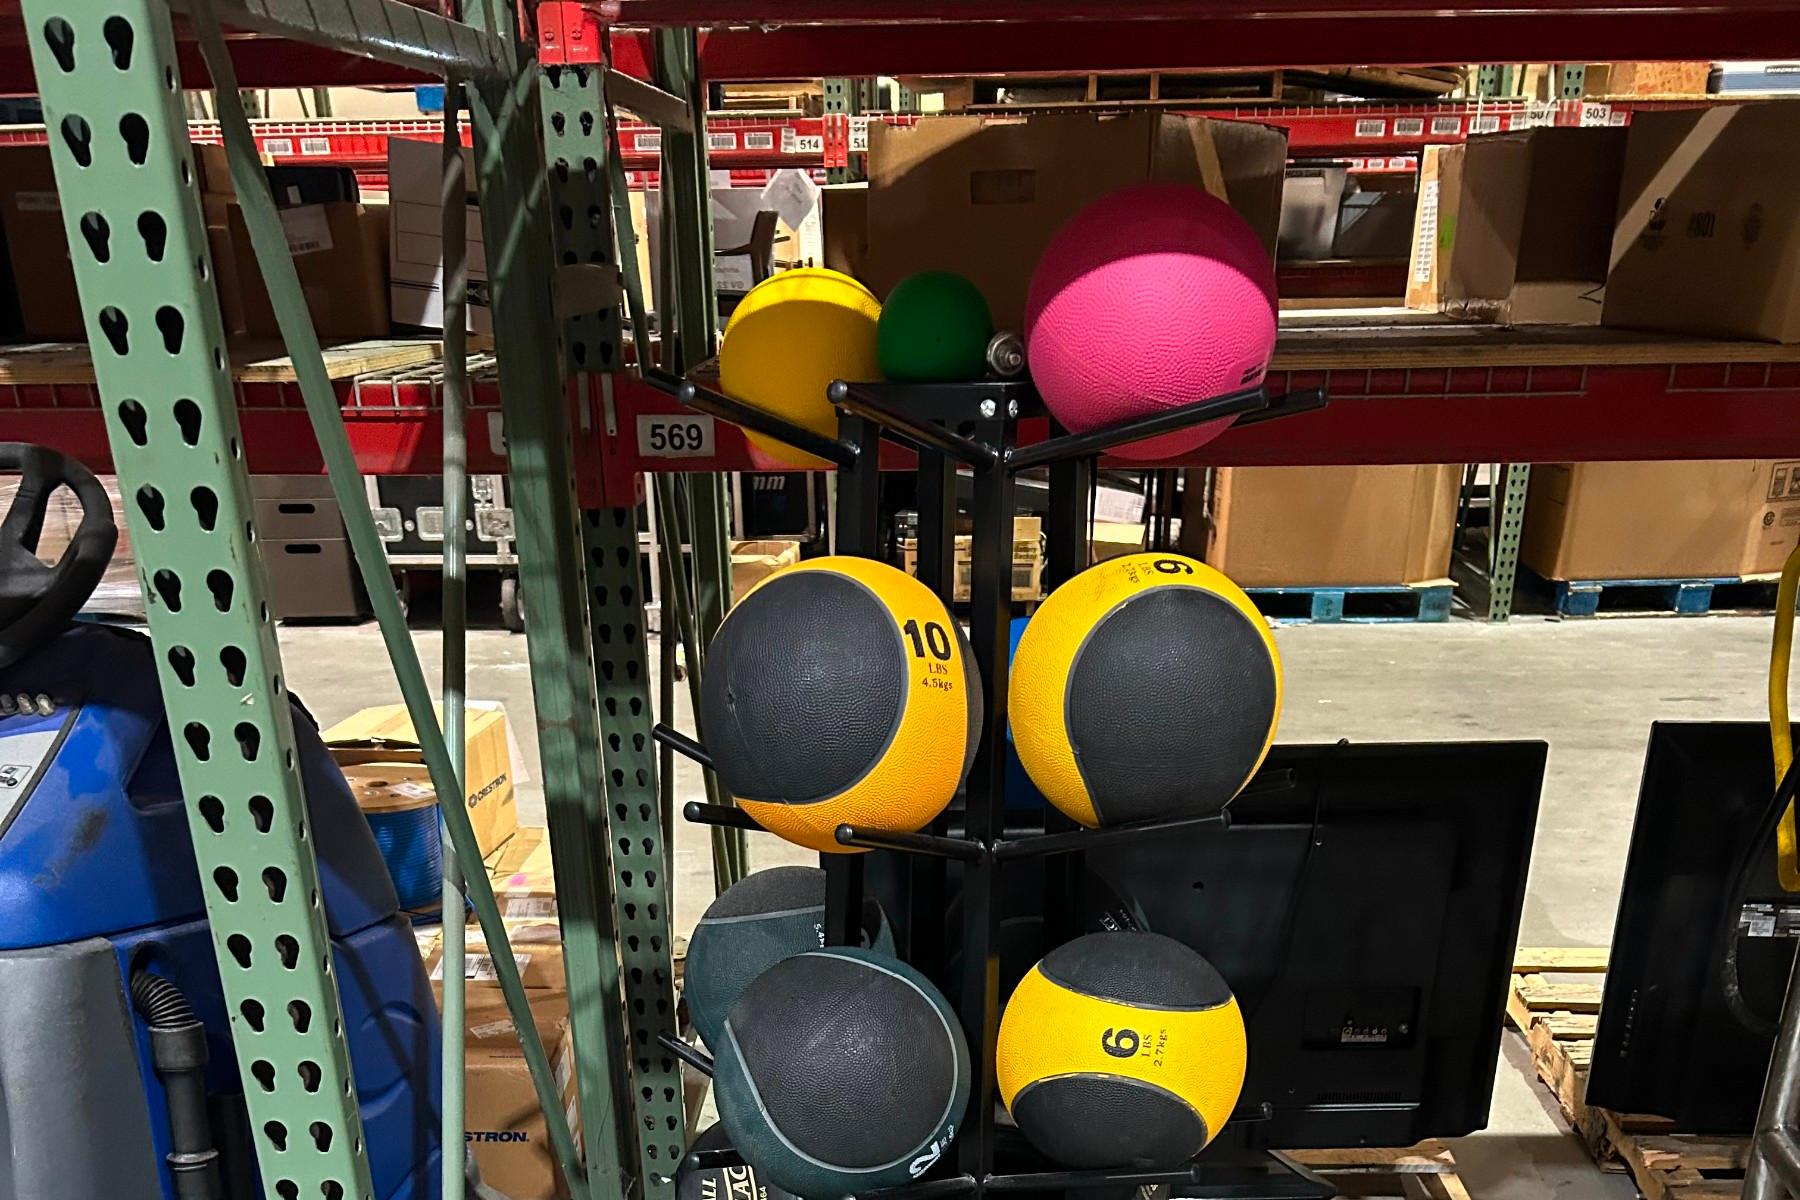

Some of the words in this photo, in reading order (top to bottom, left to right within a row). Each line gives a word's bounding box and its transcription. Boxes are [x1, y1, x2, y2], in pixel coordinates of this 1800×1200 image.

[1585, 107, 1606, 120] 503
[799, 139, 819, 150] 514
[853, 138, 866, 149] 51
[650, 422, 704, 451] 569
[903, 619, 952, 661] 10
[928, 662, 948, 675] LBS
[921, 677, 953, 692] 4.5kgs
[478, 772, 507, 801] CRESTRON
[1101, 1027, 1140, 1058] 6
[1141, 1033, 1153, 1057] LBS
[1153, 1028, 1168, 1067] 2.7kgs
[463, 1131, 530, 1143] STRON.
